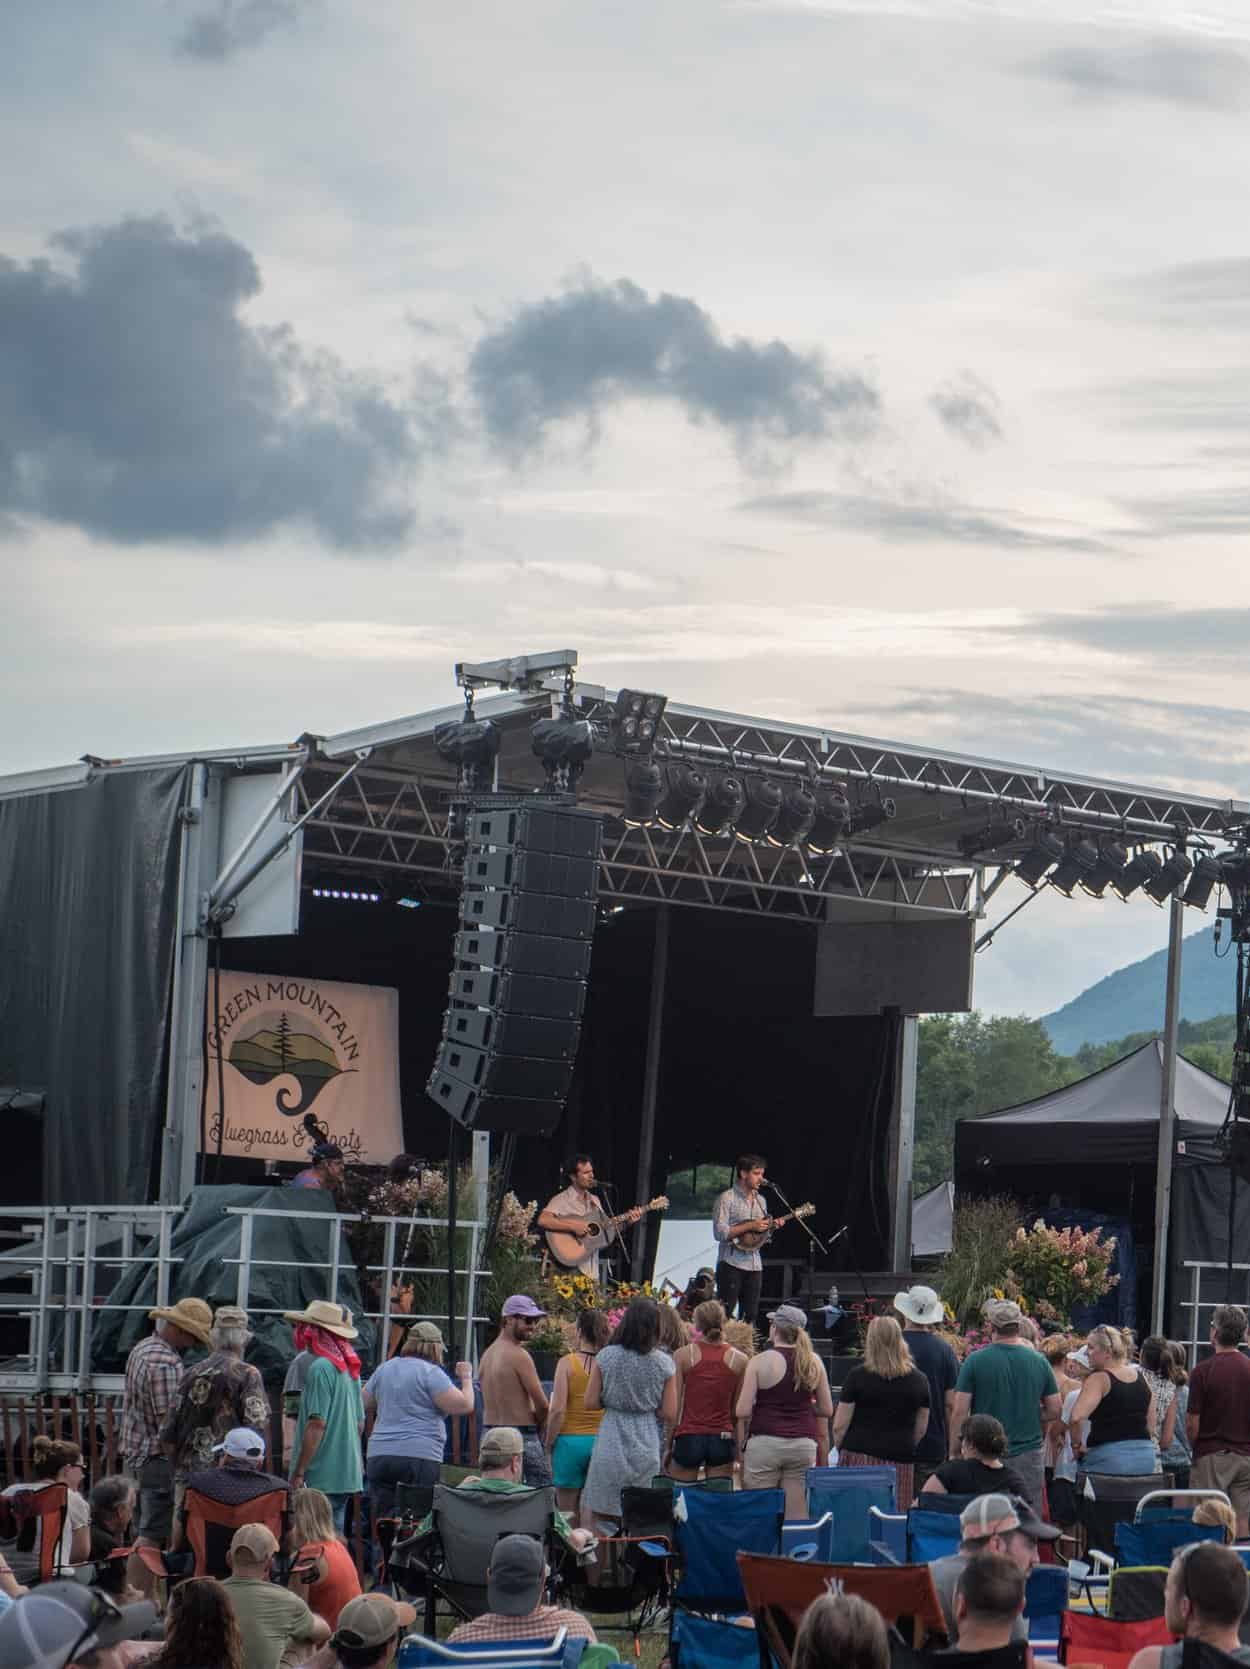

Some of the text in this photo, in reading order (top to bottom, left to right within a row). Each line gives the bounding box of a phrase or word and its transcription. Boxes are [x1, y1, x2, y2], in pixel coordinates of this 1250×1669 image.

[266, 982, 360, 1060] MOUNTAIN
[209, 1112, 289, 1153] Bluegrass
[292, 1121, 306, 1148] &
